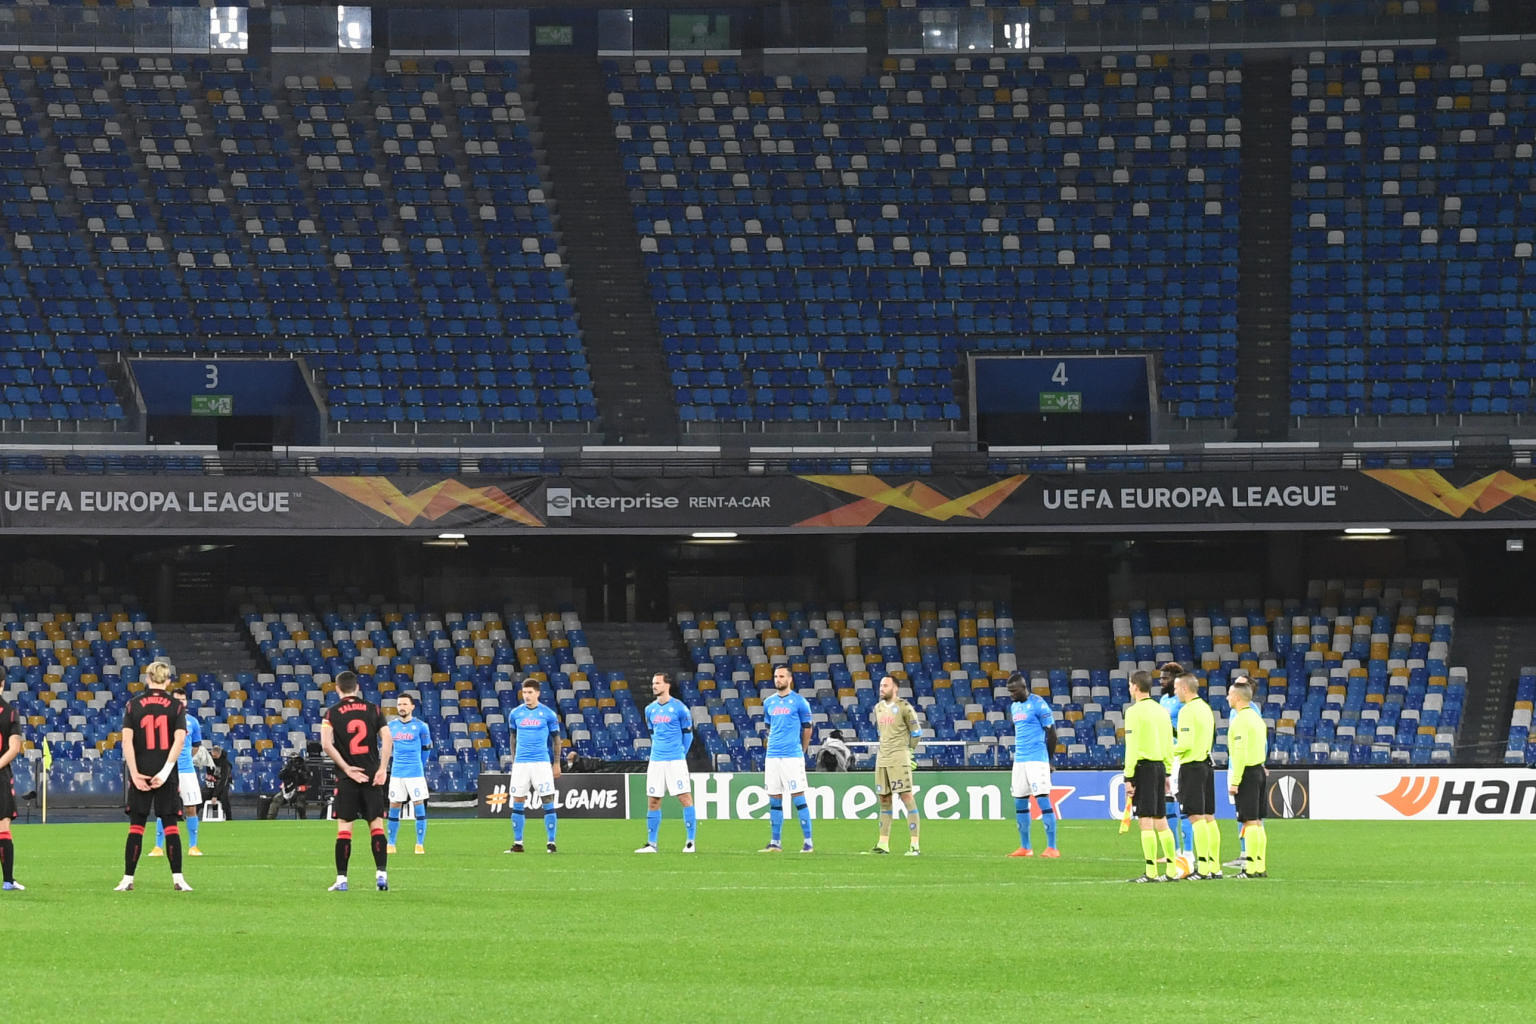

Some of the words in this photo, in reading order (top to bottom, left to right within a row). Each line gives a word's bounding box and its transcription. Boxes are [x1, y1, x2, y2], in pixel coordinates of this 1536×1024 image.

[205, 364, 219, 389] 3
[1051, 362, 1069, 386] 4
[4, 490, 73, 512] UEFA
[80, 490, 182, 513] EUROPA
[188, 491, 290, 513] LEAGUE
[547, 490, 680, 514] enterprise
[688, 496, 772, 509] RENT-A-CAR
[1042, 488, 1114, 510] UEFA
[1120, 486, 1225, 509] EUROPA
[1231, 485, 1337, 508] LEAGUE
[140, 714, 170, 750] 11
[346, 719, 370, 755] 2
[414, 787, 421, 798] 6
[538, 782, 551, 793] 22
[891, 779, 904, 791] 25
[485, 784, 618, 813] #ULGAME
